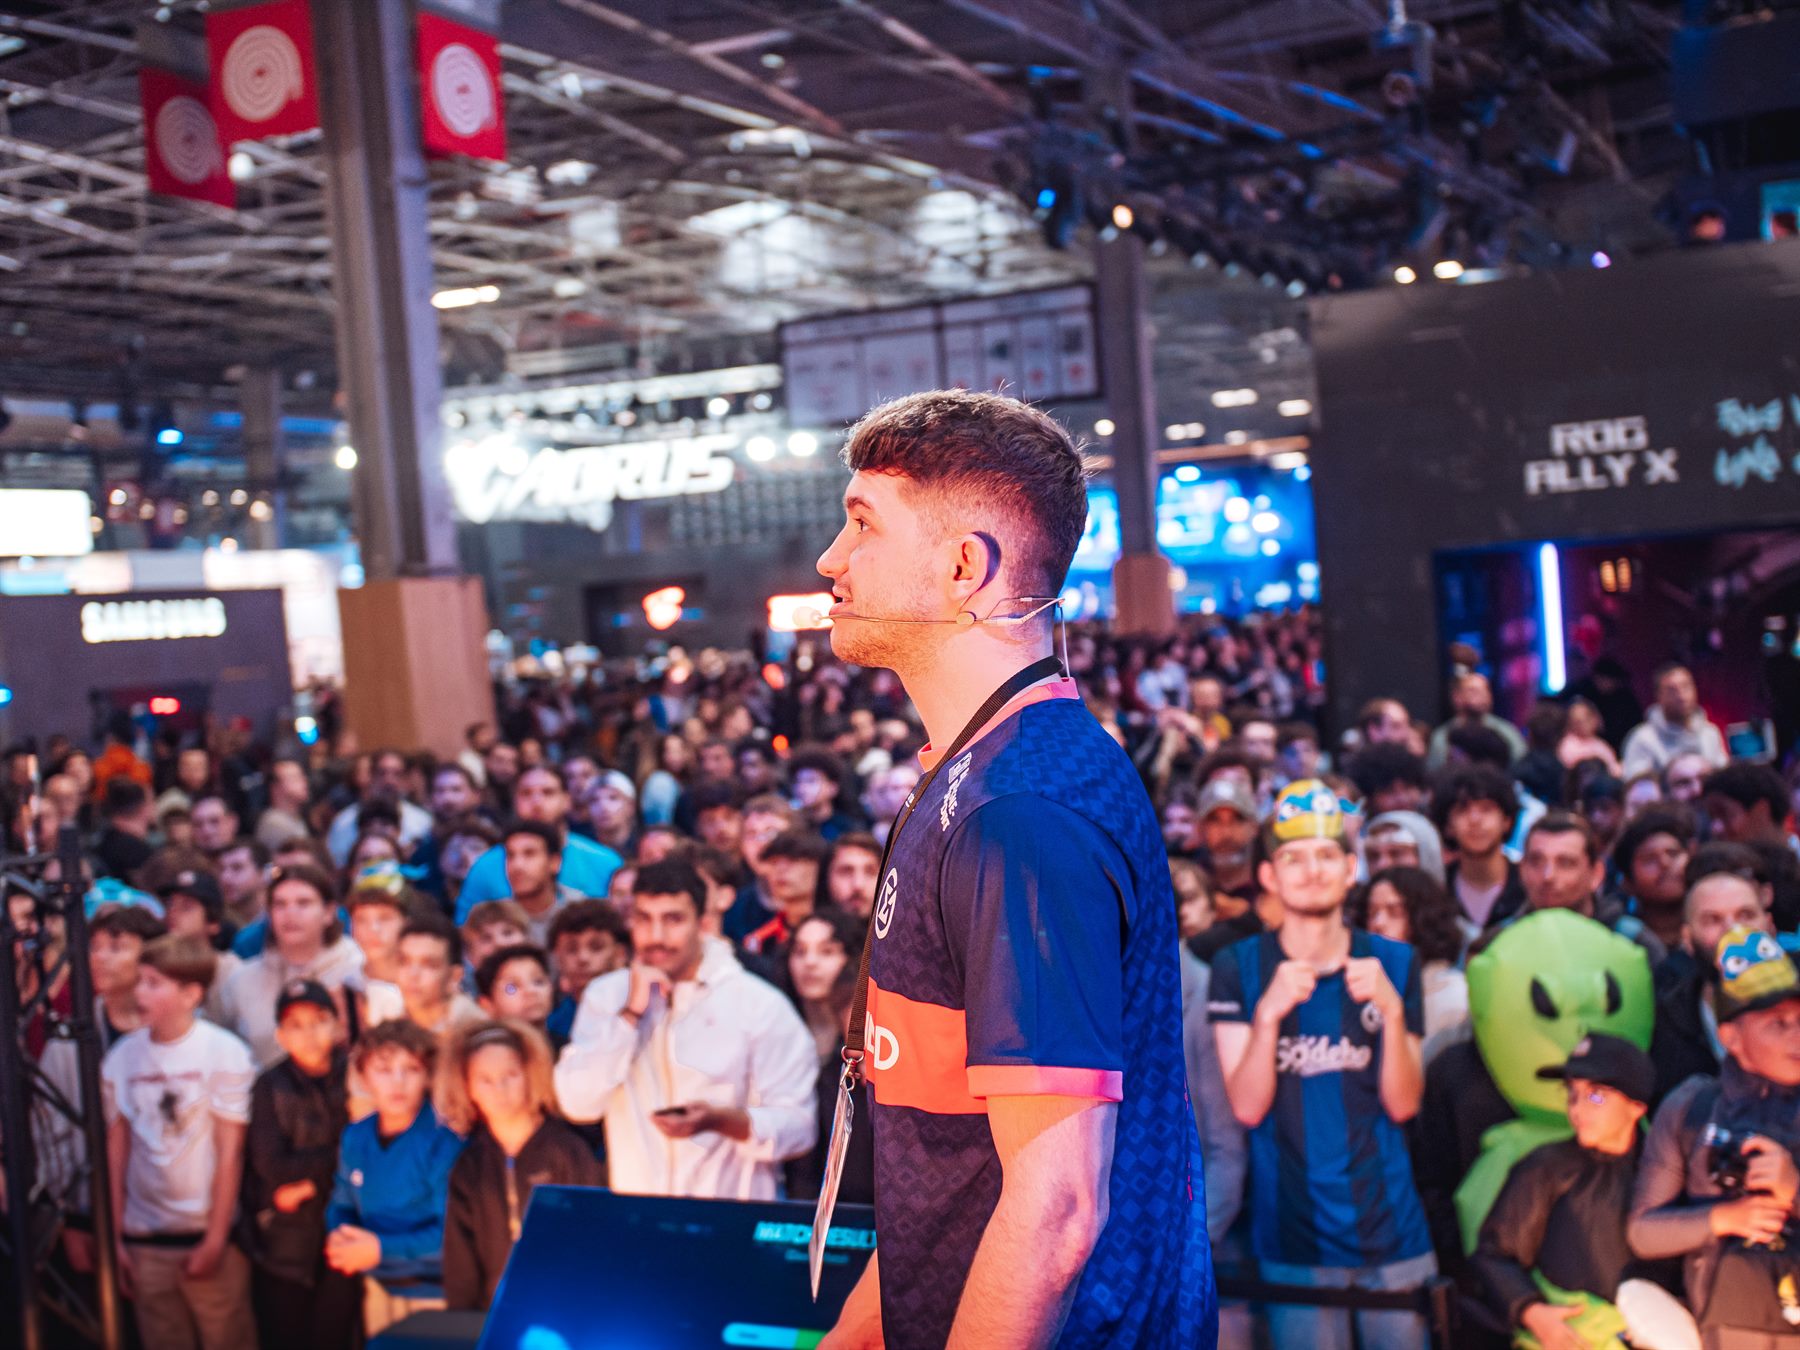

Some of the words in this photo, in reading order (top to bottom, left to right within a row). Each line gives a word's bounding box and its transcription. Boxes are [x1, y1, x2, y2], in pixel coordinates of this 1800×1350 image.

[1550, 415, 1648, 457] ROG
[1524, 452, 1636, 495] ALLY
[1644, 447, 1679, 484] X
